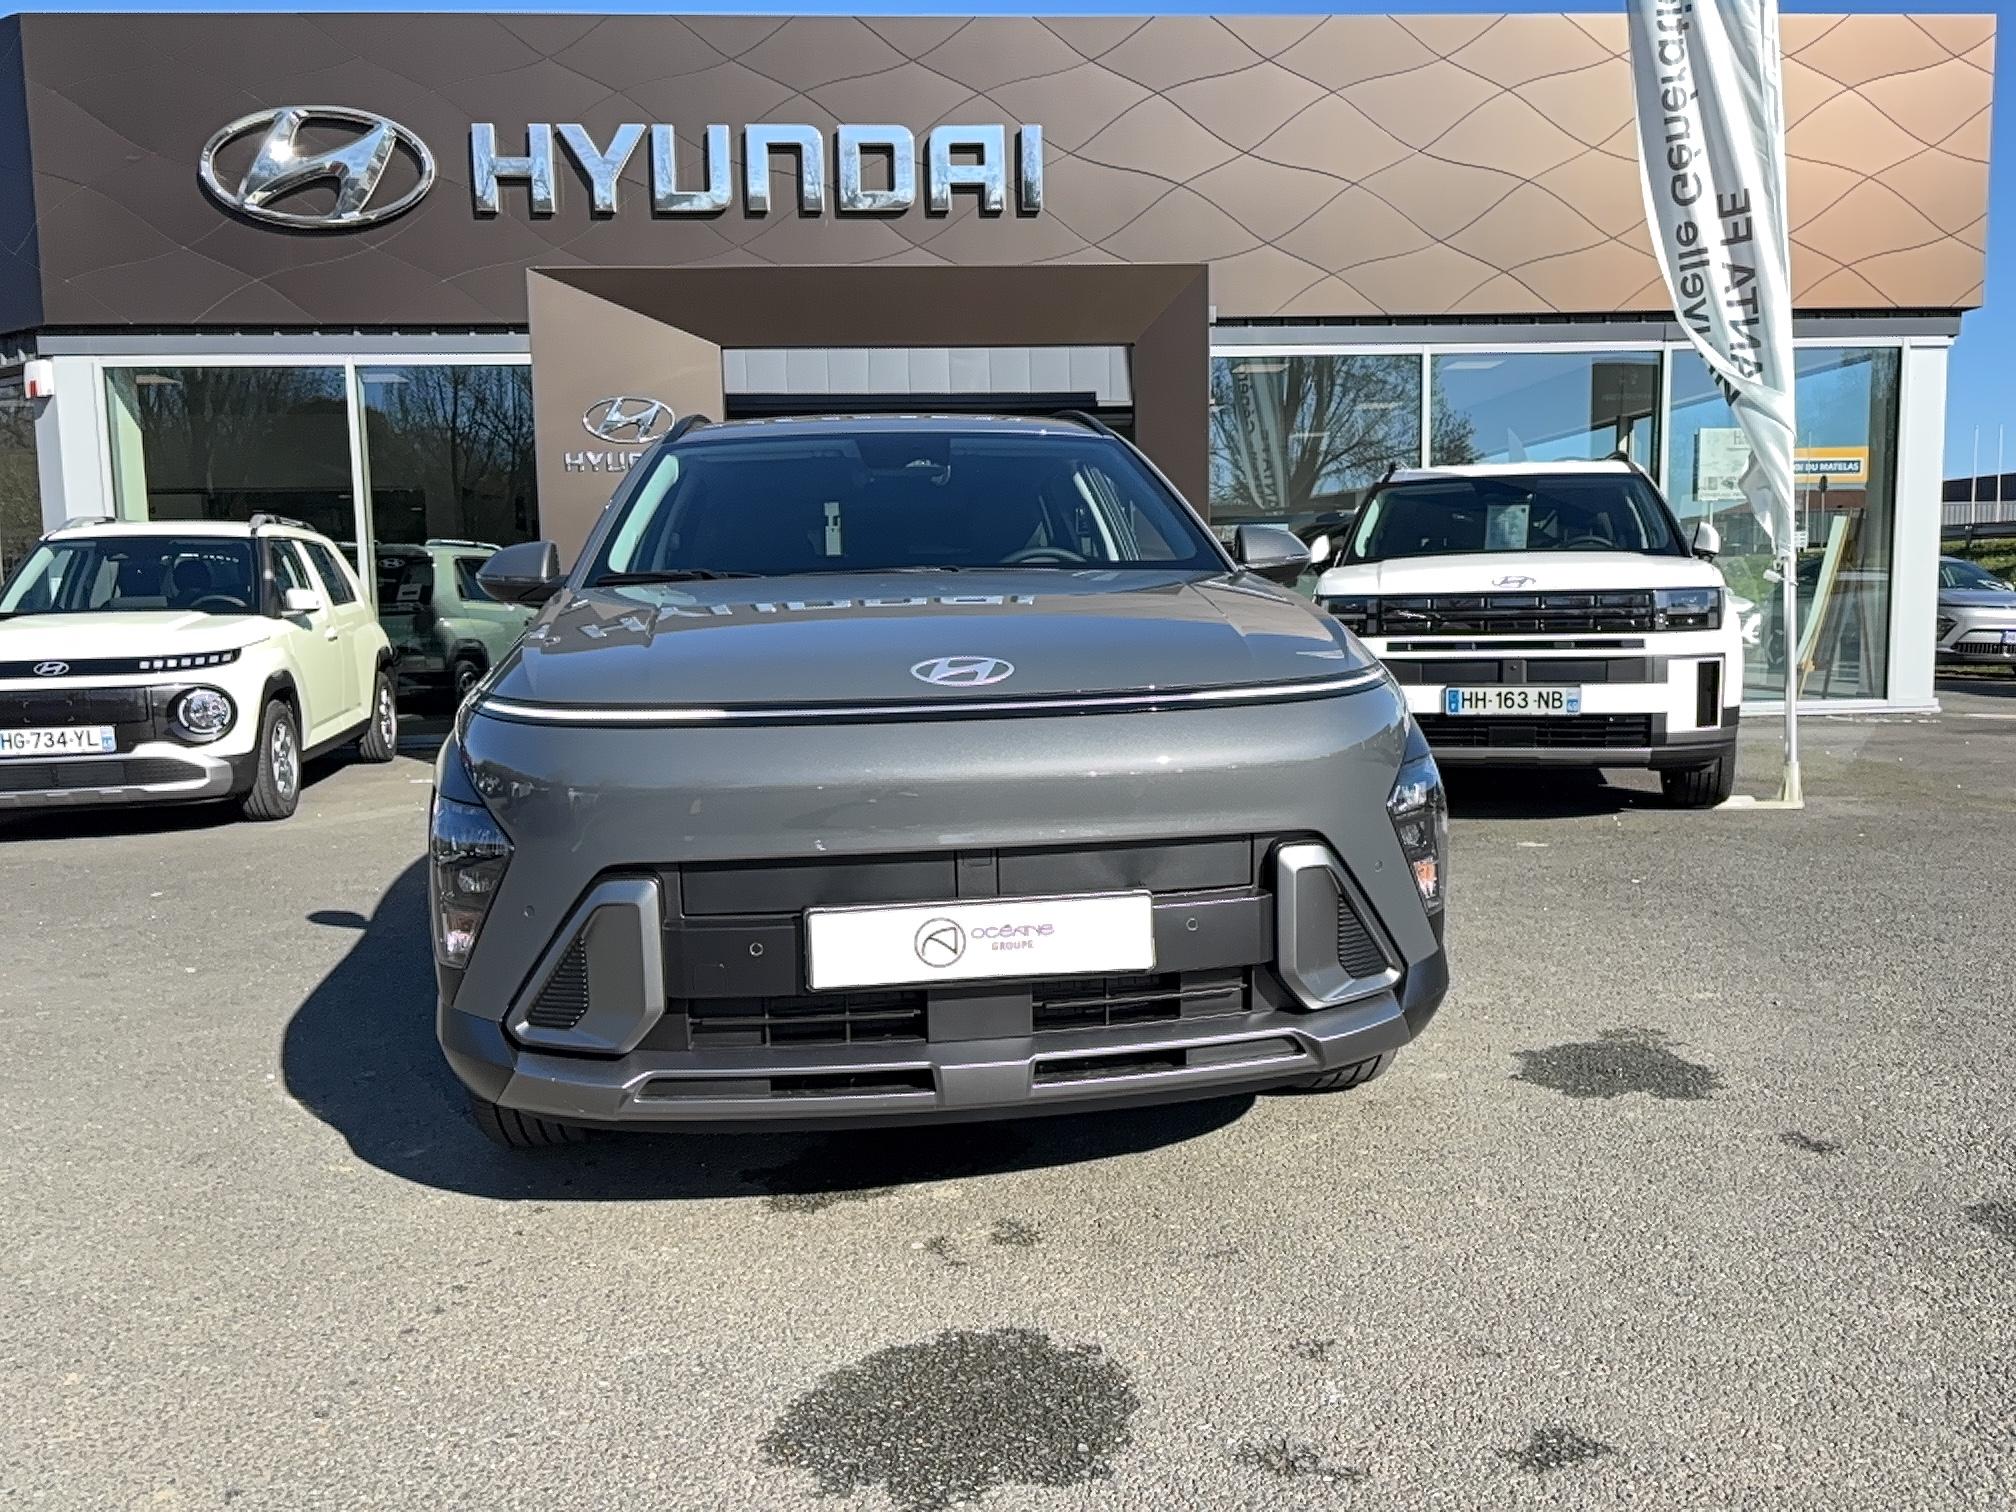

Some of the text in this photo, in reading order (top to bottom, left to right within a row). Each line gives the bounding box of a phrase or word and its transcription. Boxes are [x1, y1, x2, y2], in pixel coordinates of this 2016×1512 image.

[470, 122, 1044, 213] HYUNDAI
[1820, 462, 1858, 471] MATELAS
[1461, 691, 1563, 709] HH-163-NB
[0, 730, 99, 750] HG-734-YL
[991, 940, 1034, 951] GROUPE
